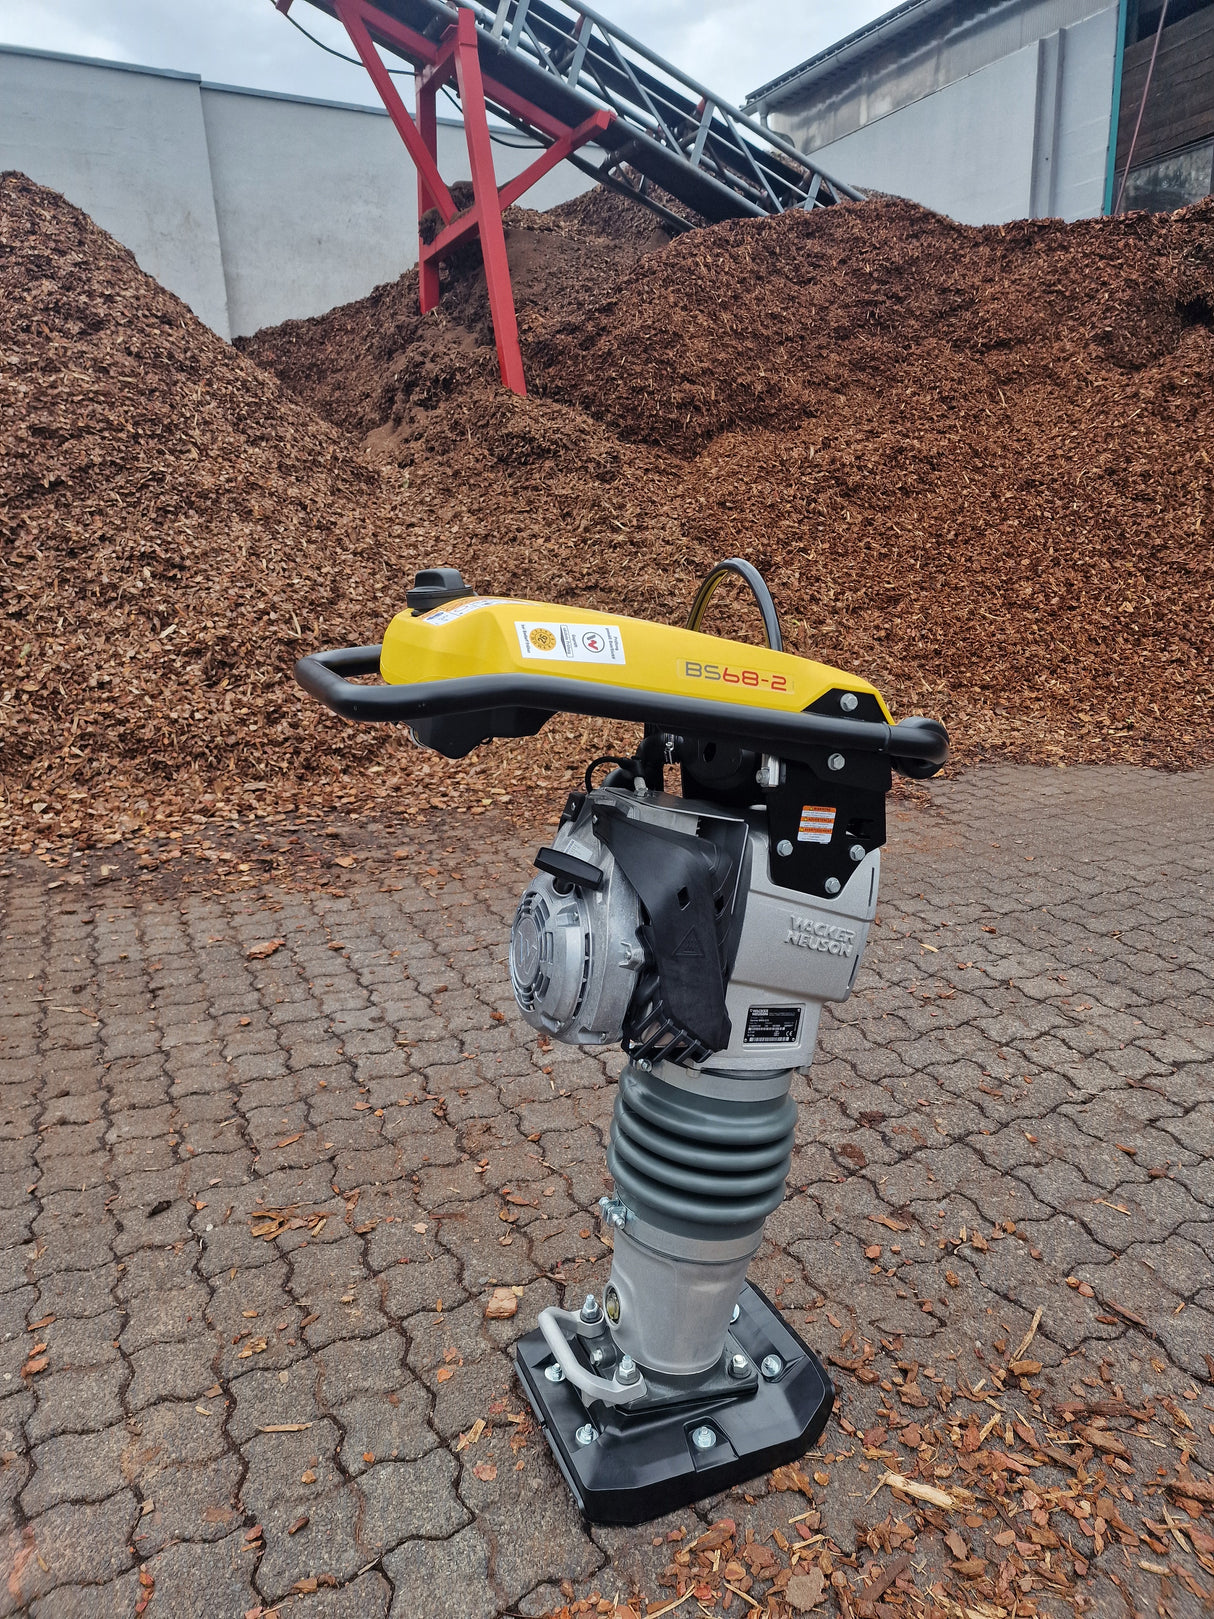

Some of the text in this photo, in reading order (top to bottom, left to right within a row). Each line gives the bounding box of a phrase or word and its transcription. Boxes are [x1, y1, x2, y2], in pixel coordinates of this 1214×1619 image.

[685, 661, 787, 692] BS68-2
[784, 929, 854, 958] NEUSON
[791, 914, 856, 944] WACKER
